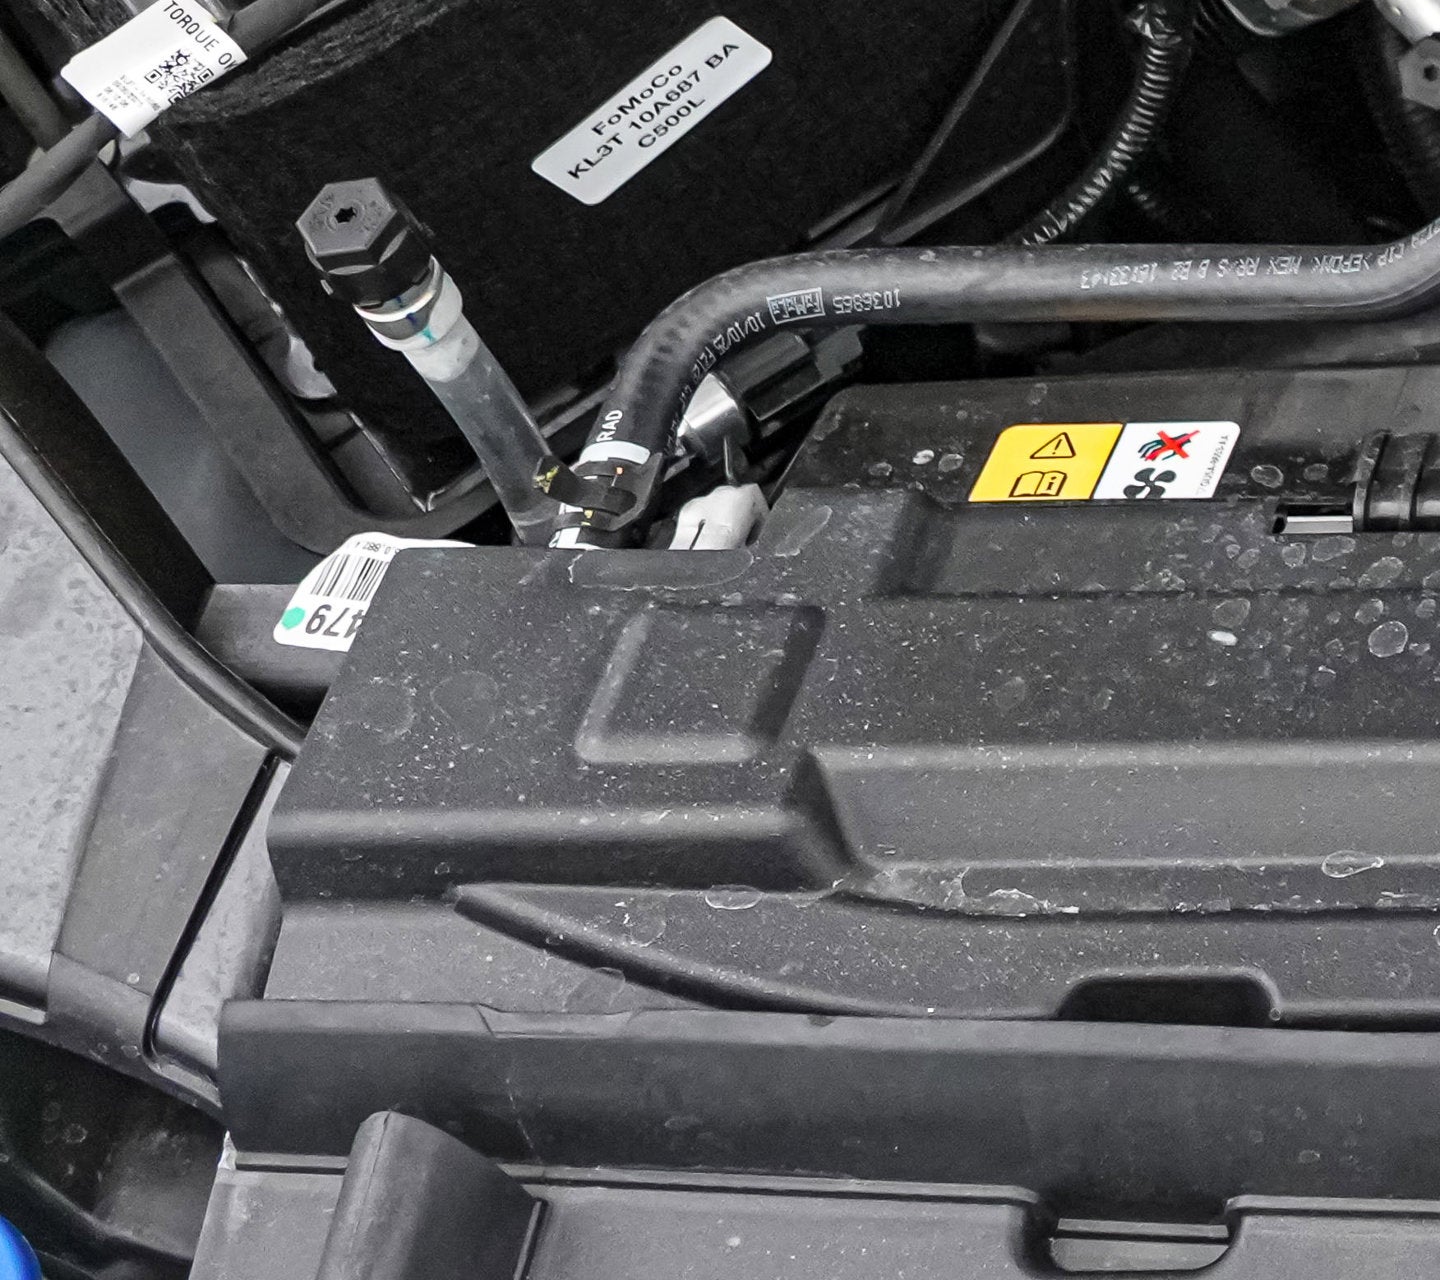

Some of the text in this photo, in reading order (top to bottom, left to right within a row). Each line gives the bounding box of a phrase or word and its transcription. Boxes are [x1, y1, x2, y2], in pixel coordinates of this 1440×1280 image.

[164, 0, 219, 52] TORQUE
[568, 43, 739, 179] KL3T 10A687 BA
[592, 65, 682, 135] FoMoCo
[638, 97, 705, 149] C500L
[596, 409, 622, 442] RAD
